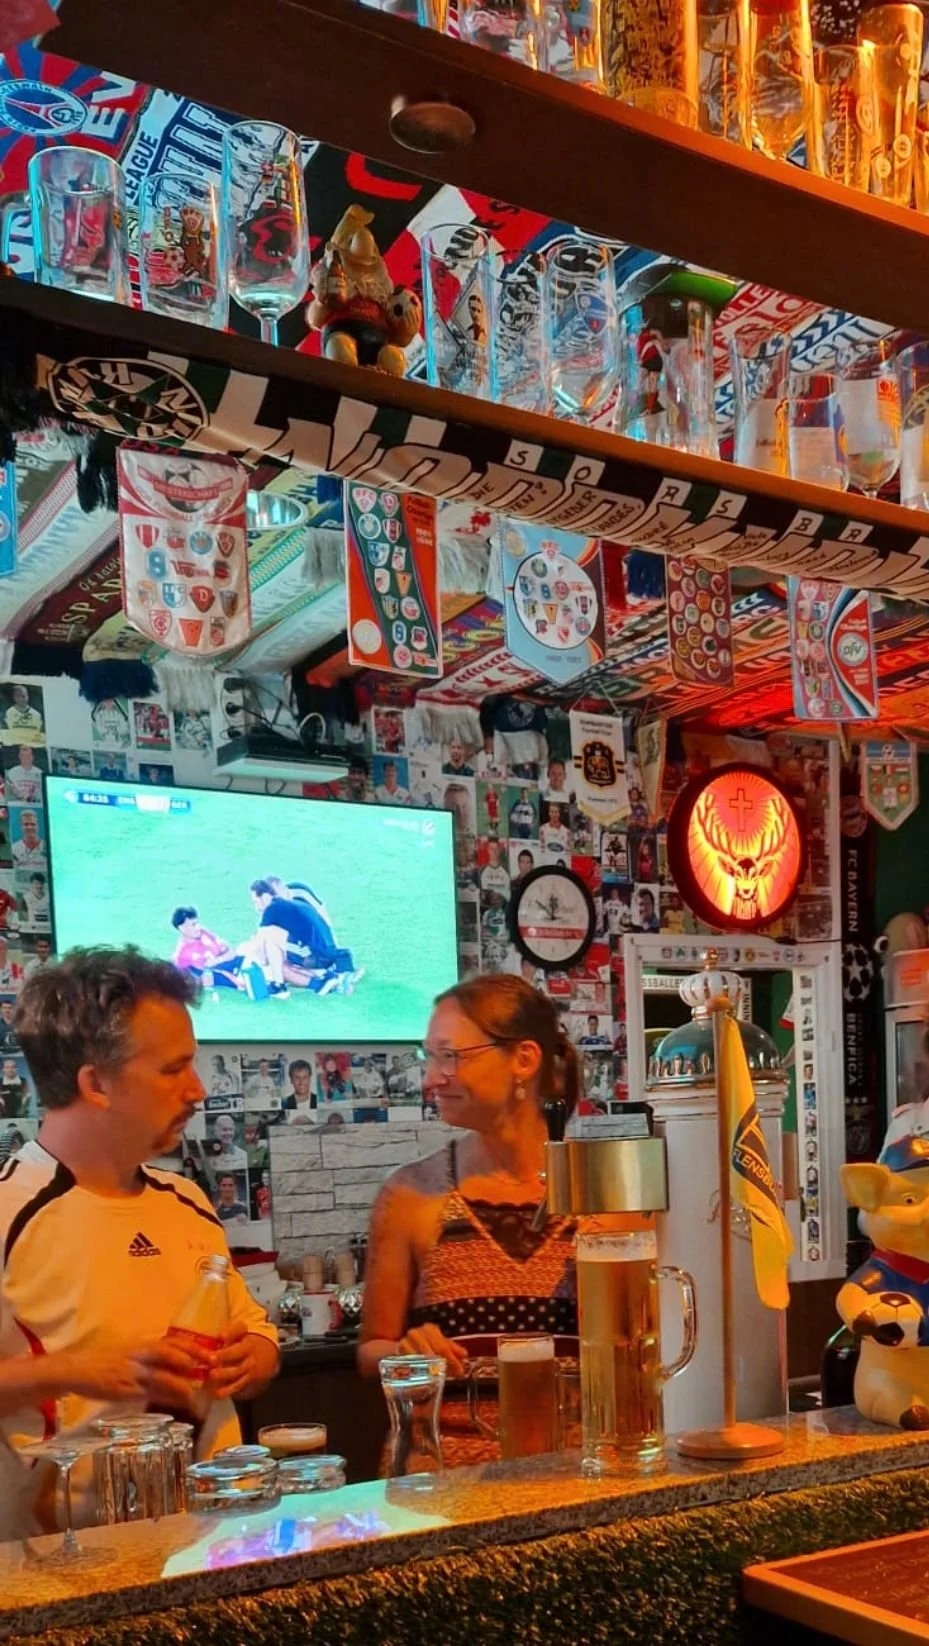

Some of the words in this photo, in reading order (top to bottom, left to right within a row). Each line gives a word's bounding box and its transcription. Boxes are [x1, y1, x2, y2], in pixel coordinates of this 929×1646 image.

[125, 131, 158, 200] LEAGUE
[469, 482, 496, 501] DIE
[847, 849, 858, 867] FC
[846, 871, 859, 933] BAYERN
[846, 1012, 858, 1086] BENFICA
[128, 1246, 161, 1258] adidas
